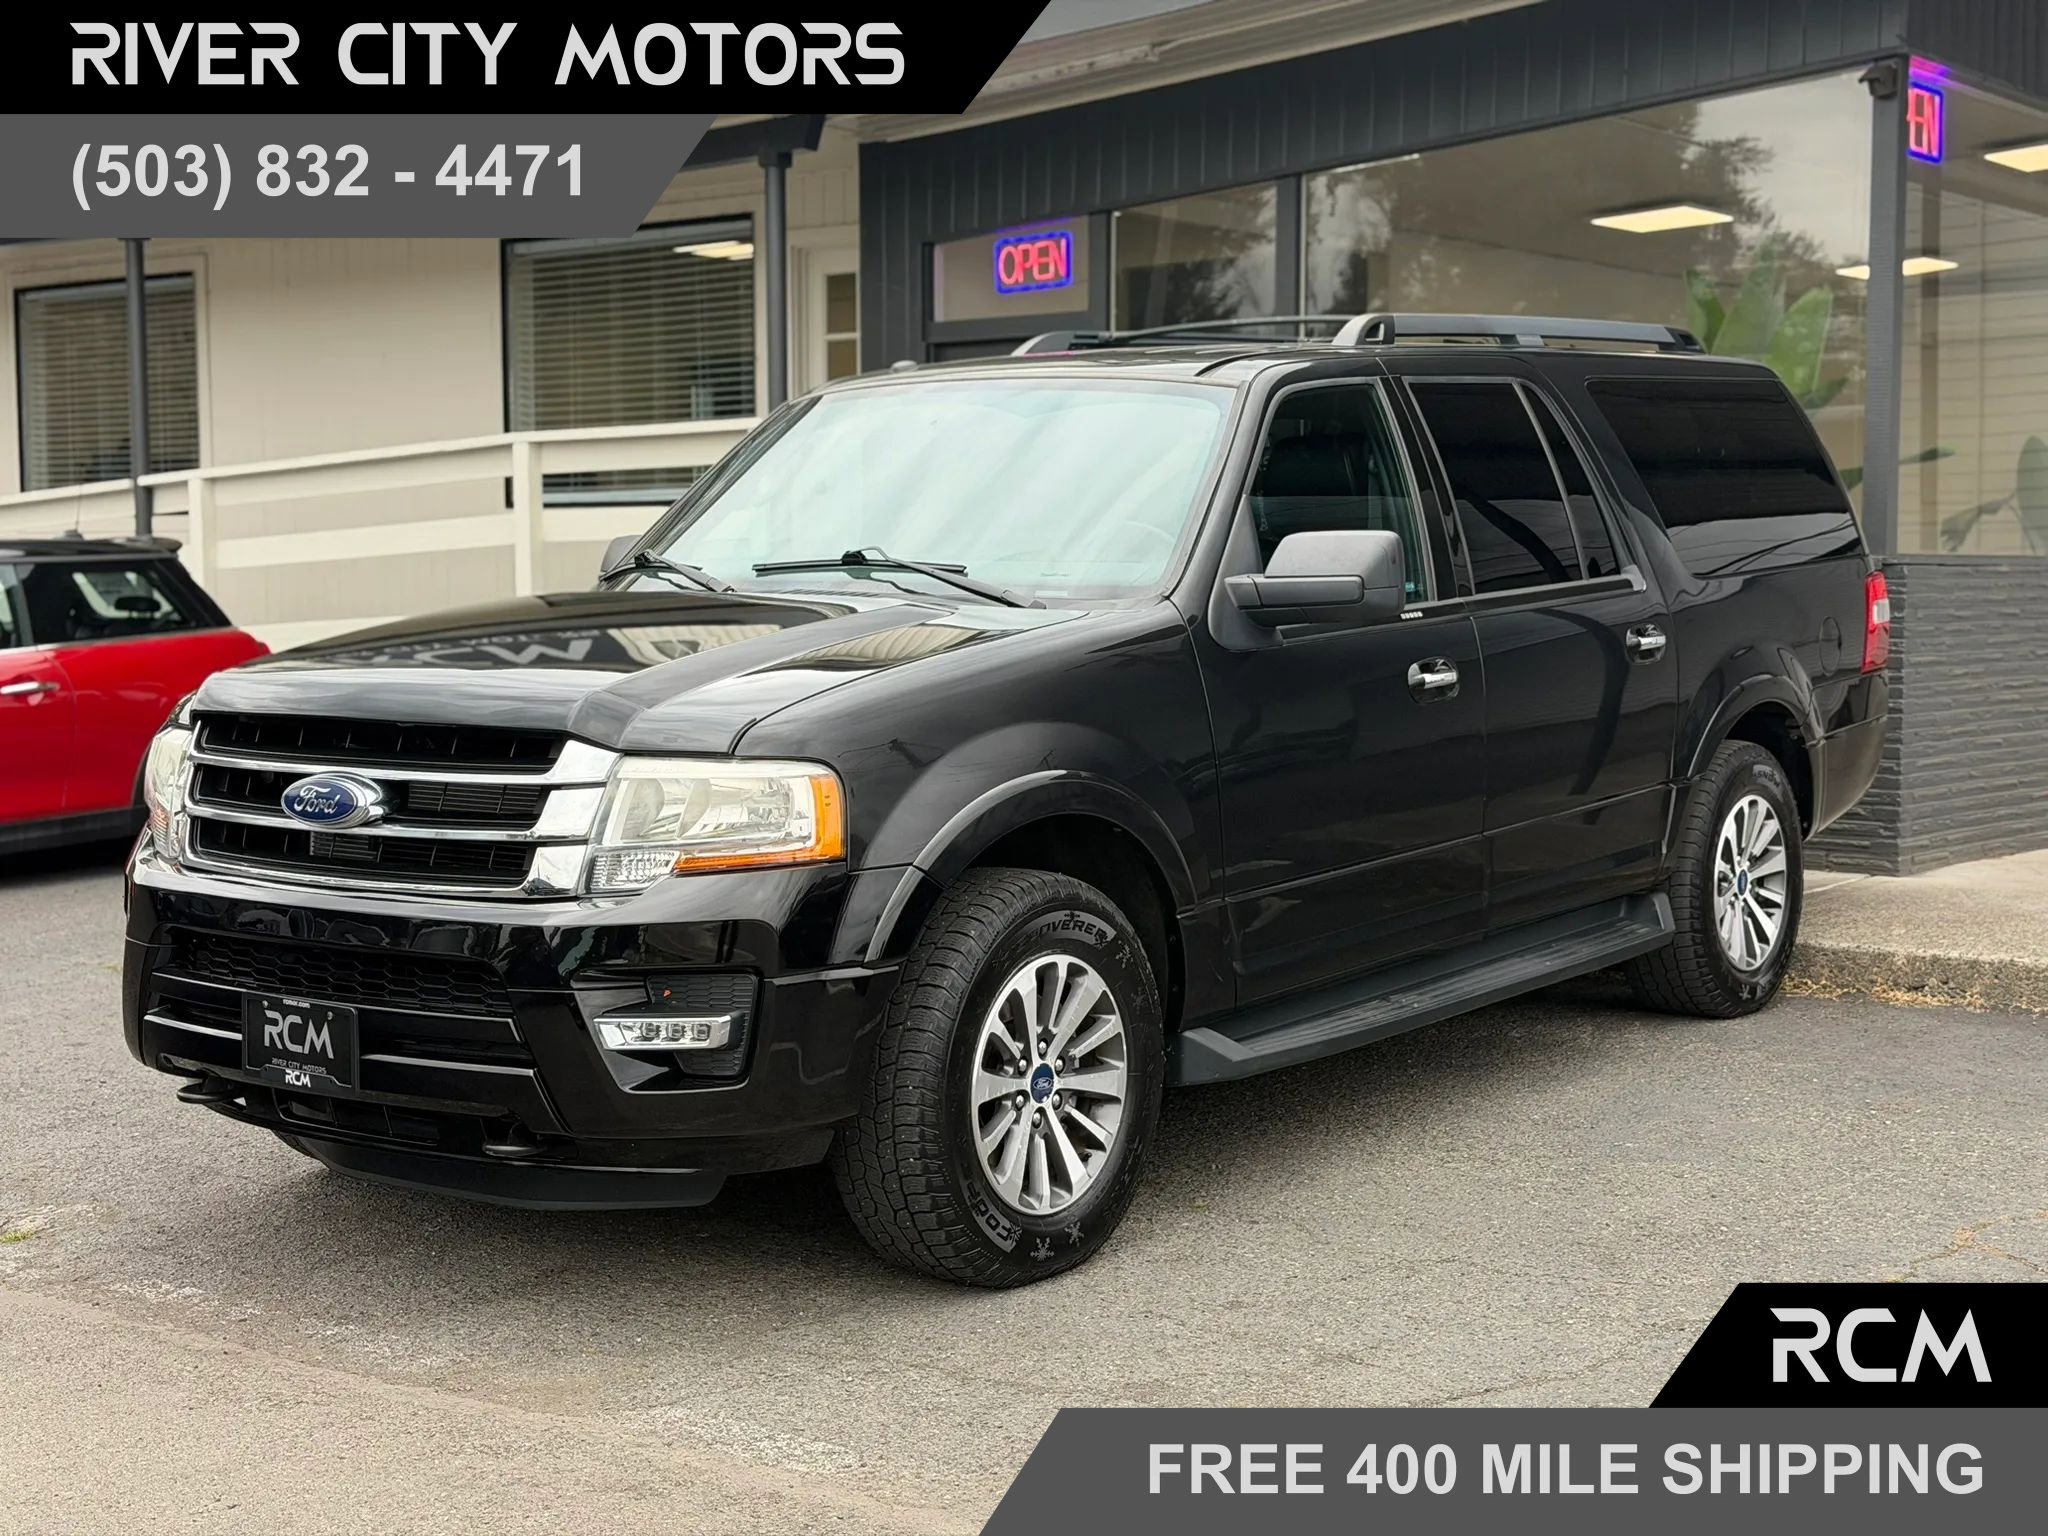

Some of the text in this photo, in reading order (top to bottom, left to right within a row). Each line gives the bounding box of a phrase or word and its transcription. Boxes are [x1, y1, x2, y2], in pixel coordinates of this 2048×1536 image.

[998, 237, 1066, 285] OPEN
[293, 785, 341, 814] Ford
[264, 1009, 334, 1059] RCM
[285, 1069, 311, 1088] RCM
